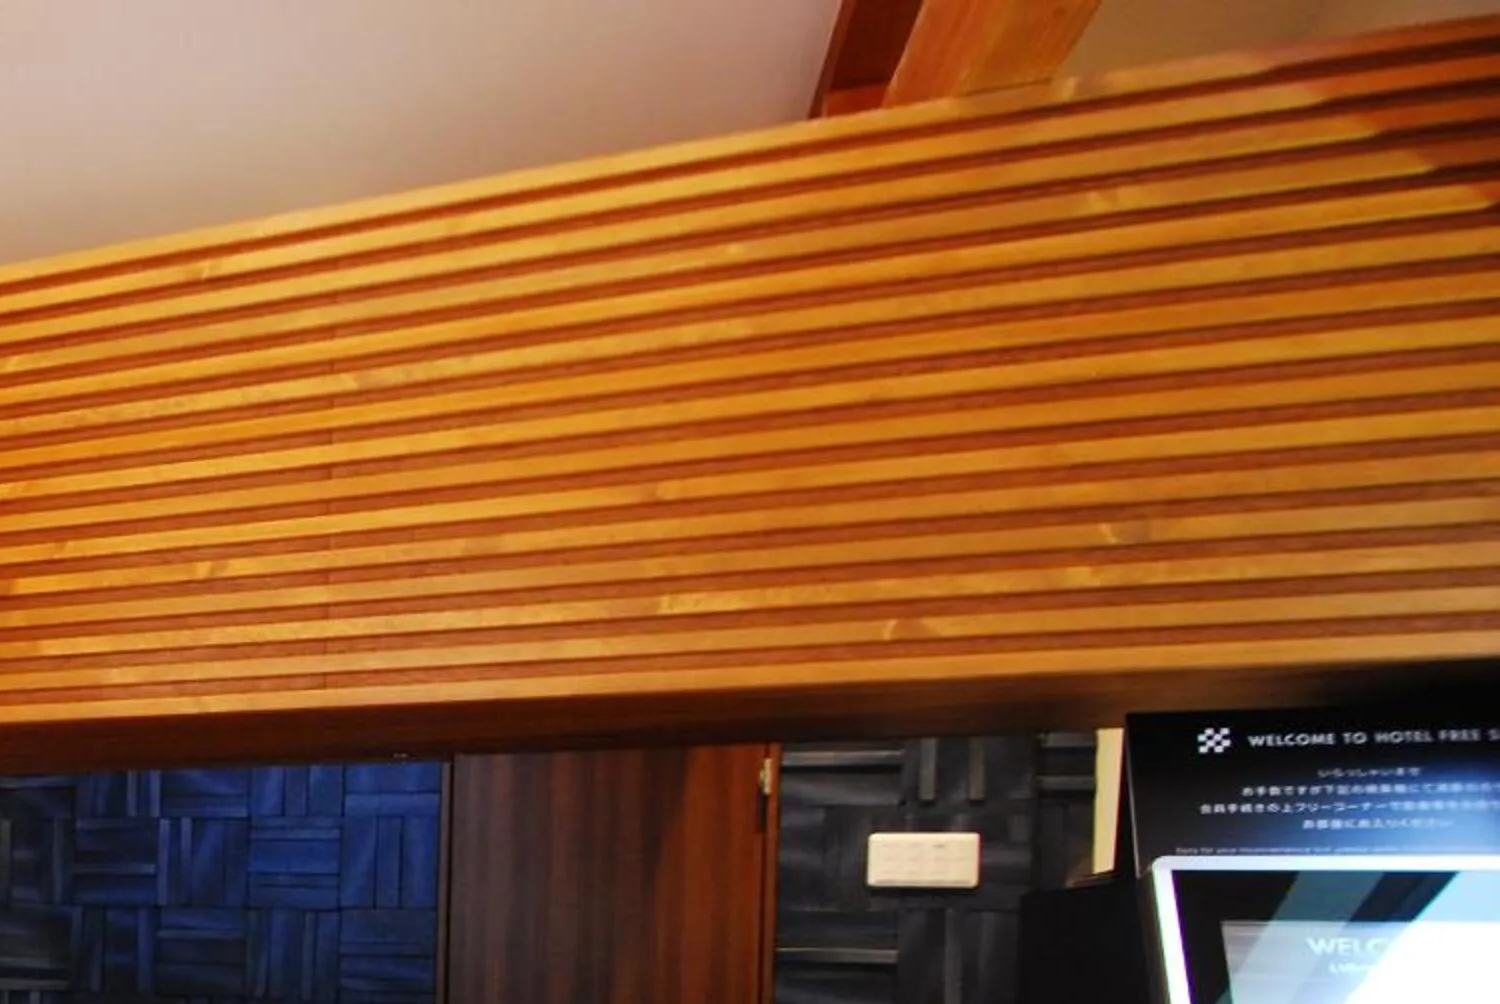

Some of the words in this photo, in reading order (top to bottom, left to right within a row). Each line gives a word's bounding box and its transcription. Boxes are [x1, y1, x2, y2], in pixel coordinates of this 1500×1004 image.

[1248, 733, 1335, 747] WELCOME
[1343, 732, 1367, 744] TO
[1375, 731, 1434, 743] HOTEL
[1438, 729, 1481, 741] FREE
